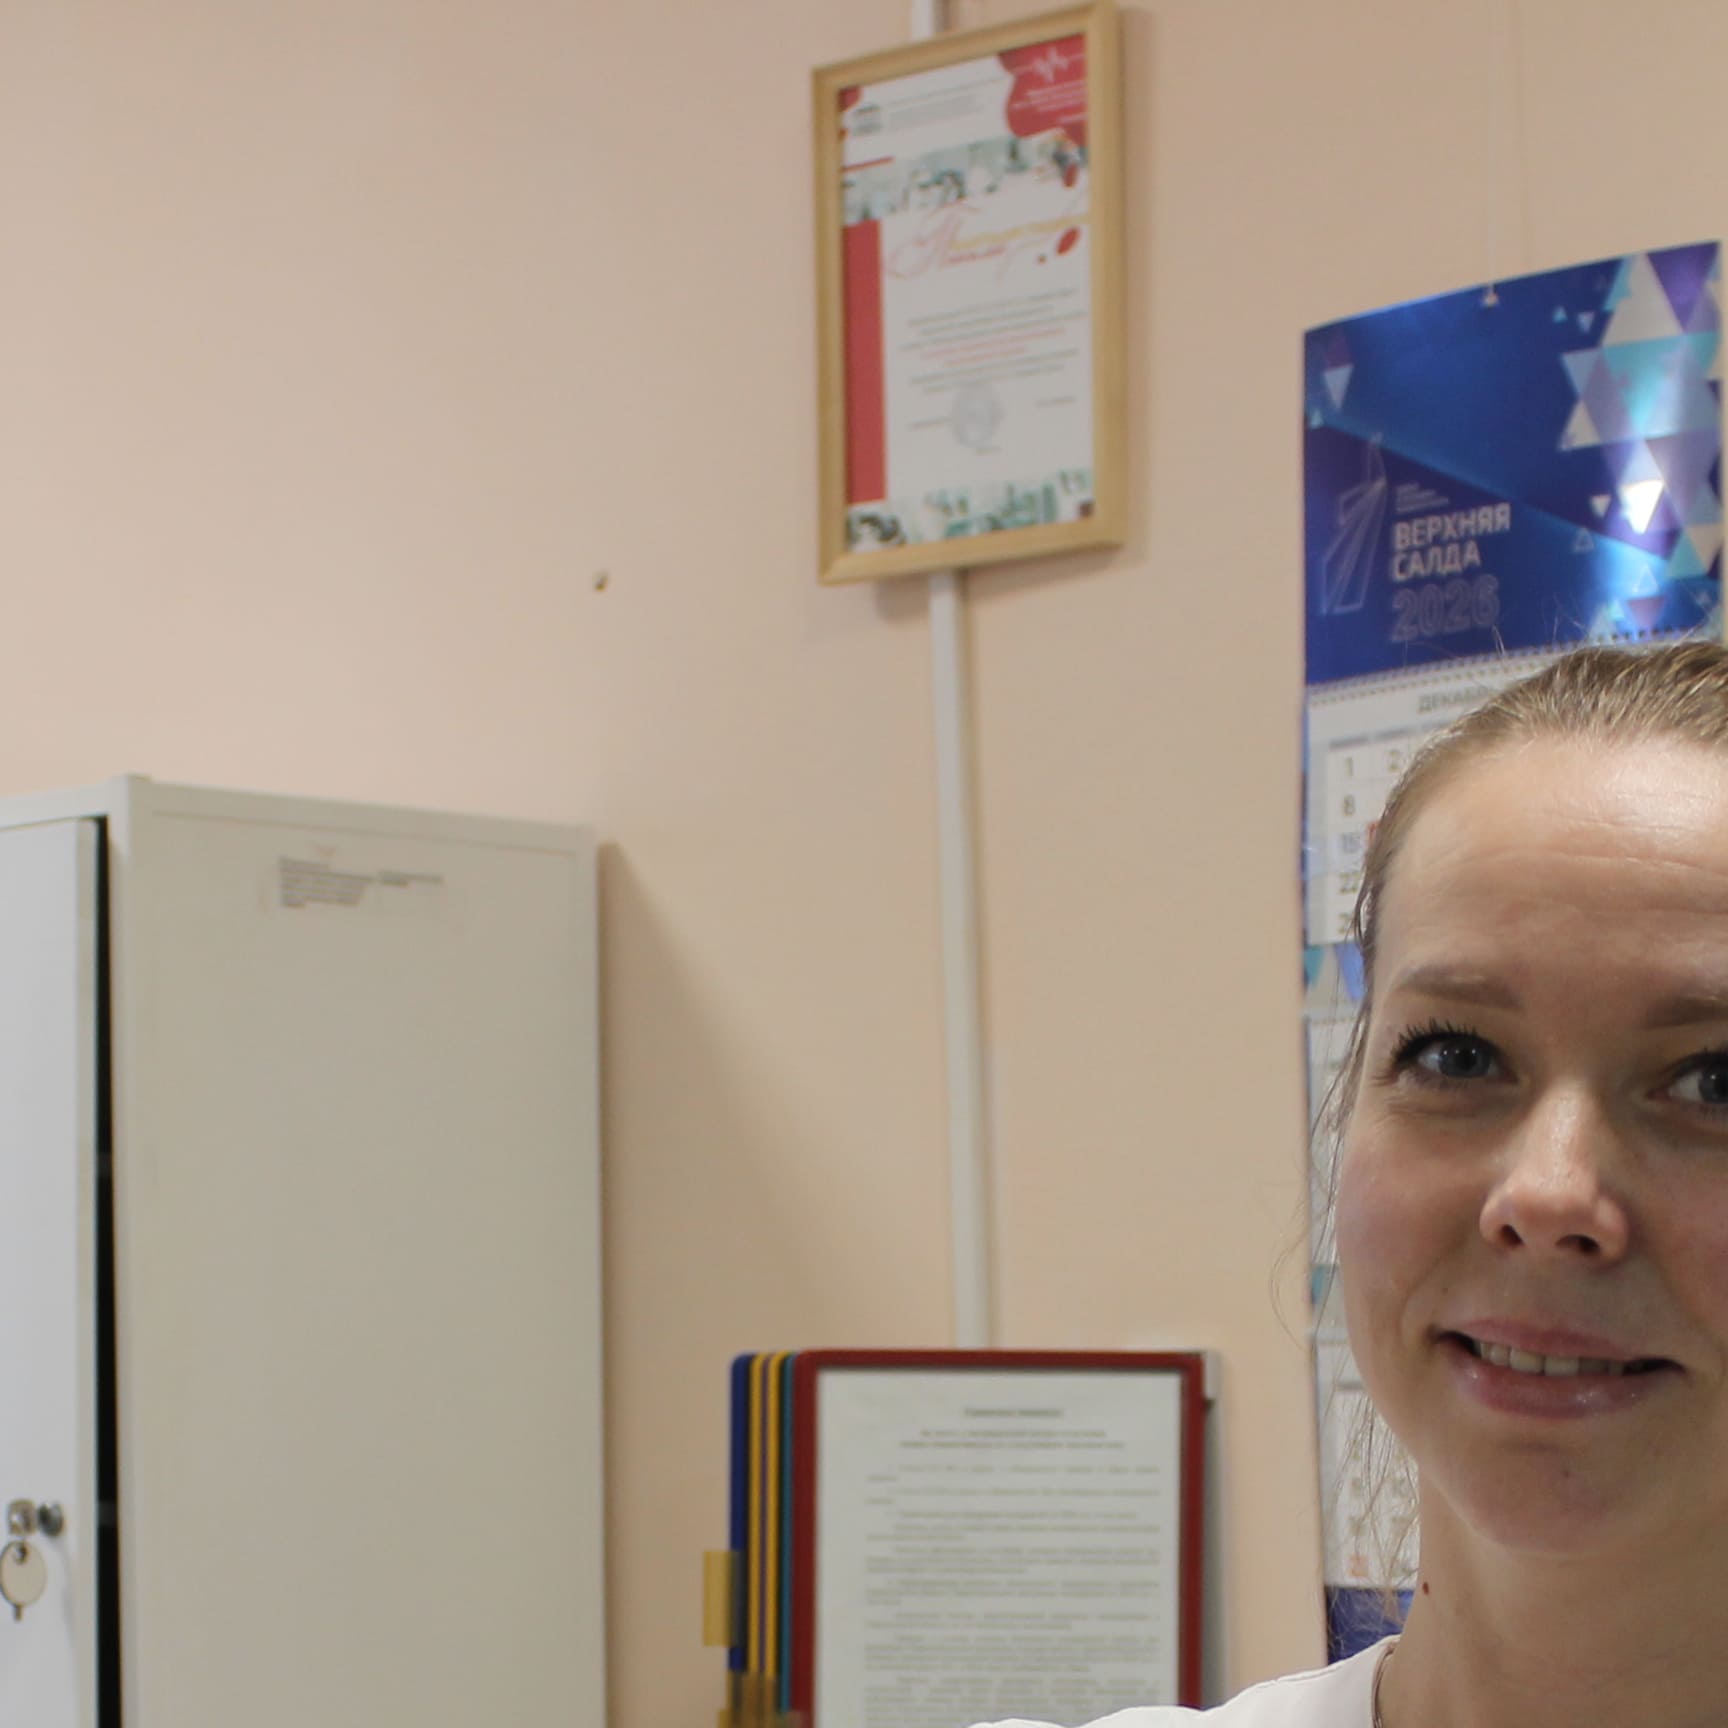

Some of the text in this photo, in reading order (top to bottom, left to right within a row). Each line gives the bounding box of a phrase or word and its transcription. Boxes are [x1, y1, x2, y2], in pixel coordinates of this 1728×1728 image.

[1393, 502, 1512, 551] ВЕРХНЯЯ
[1392, 540, 1481, 582] САЛДА
[1391, 573, 1500, 643] 2026
